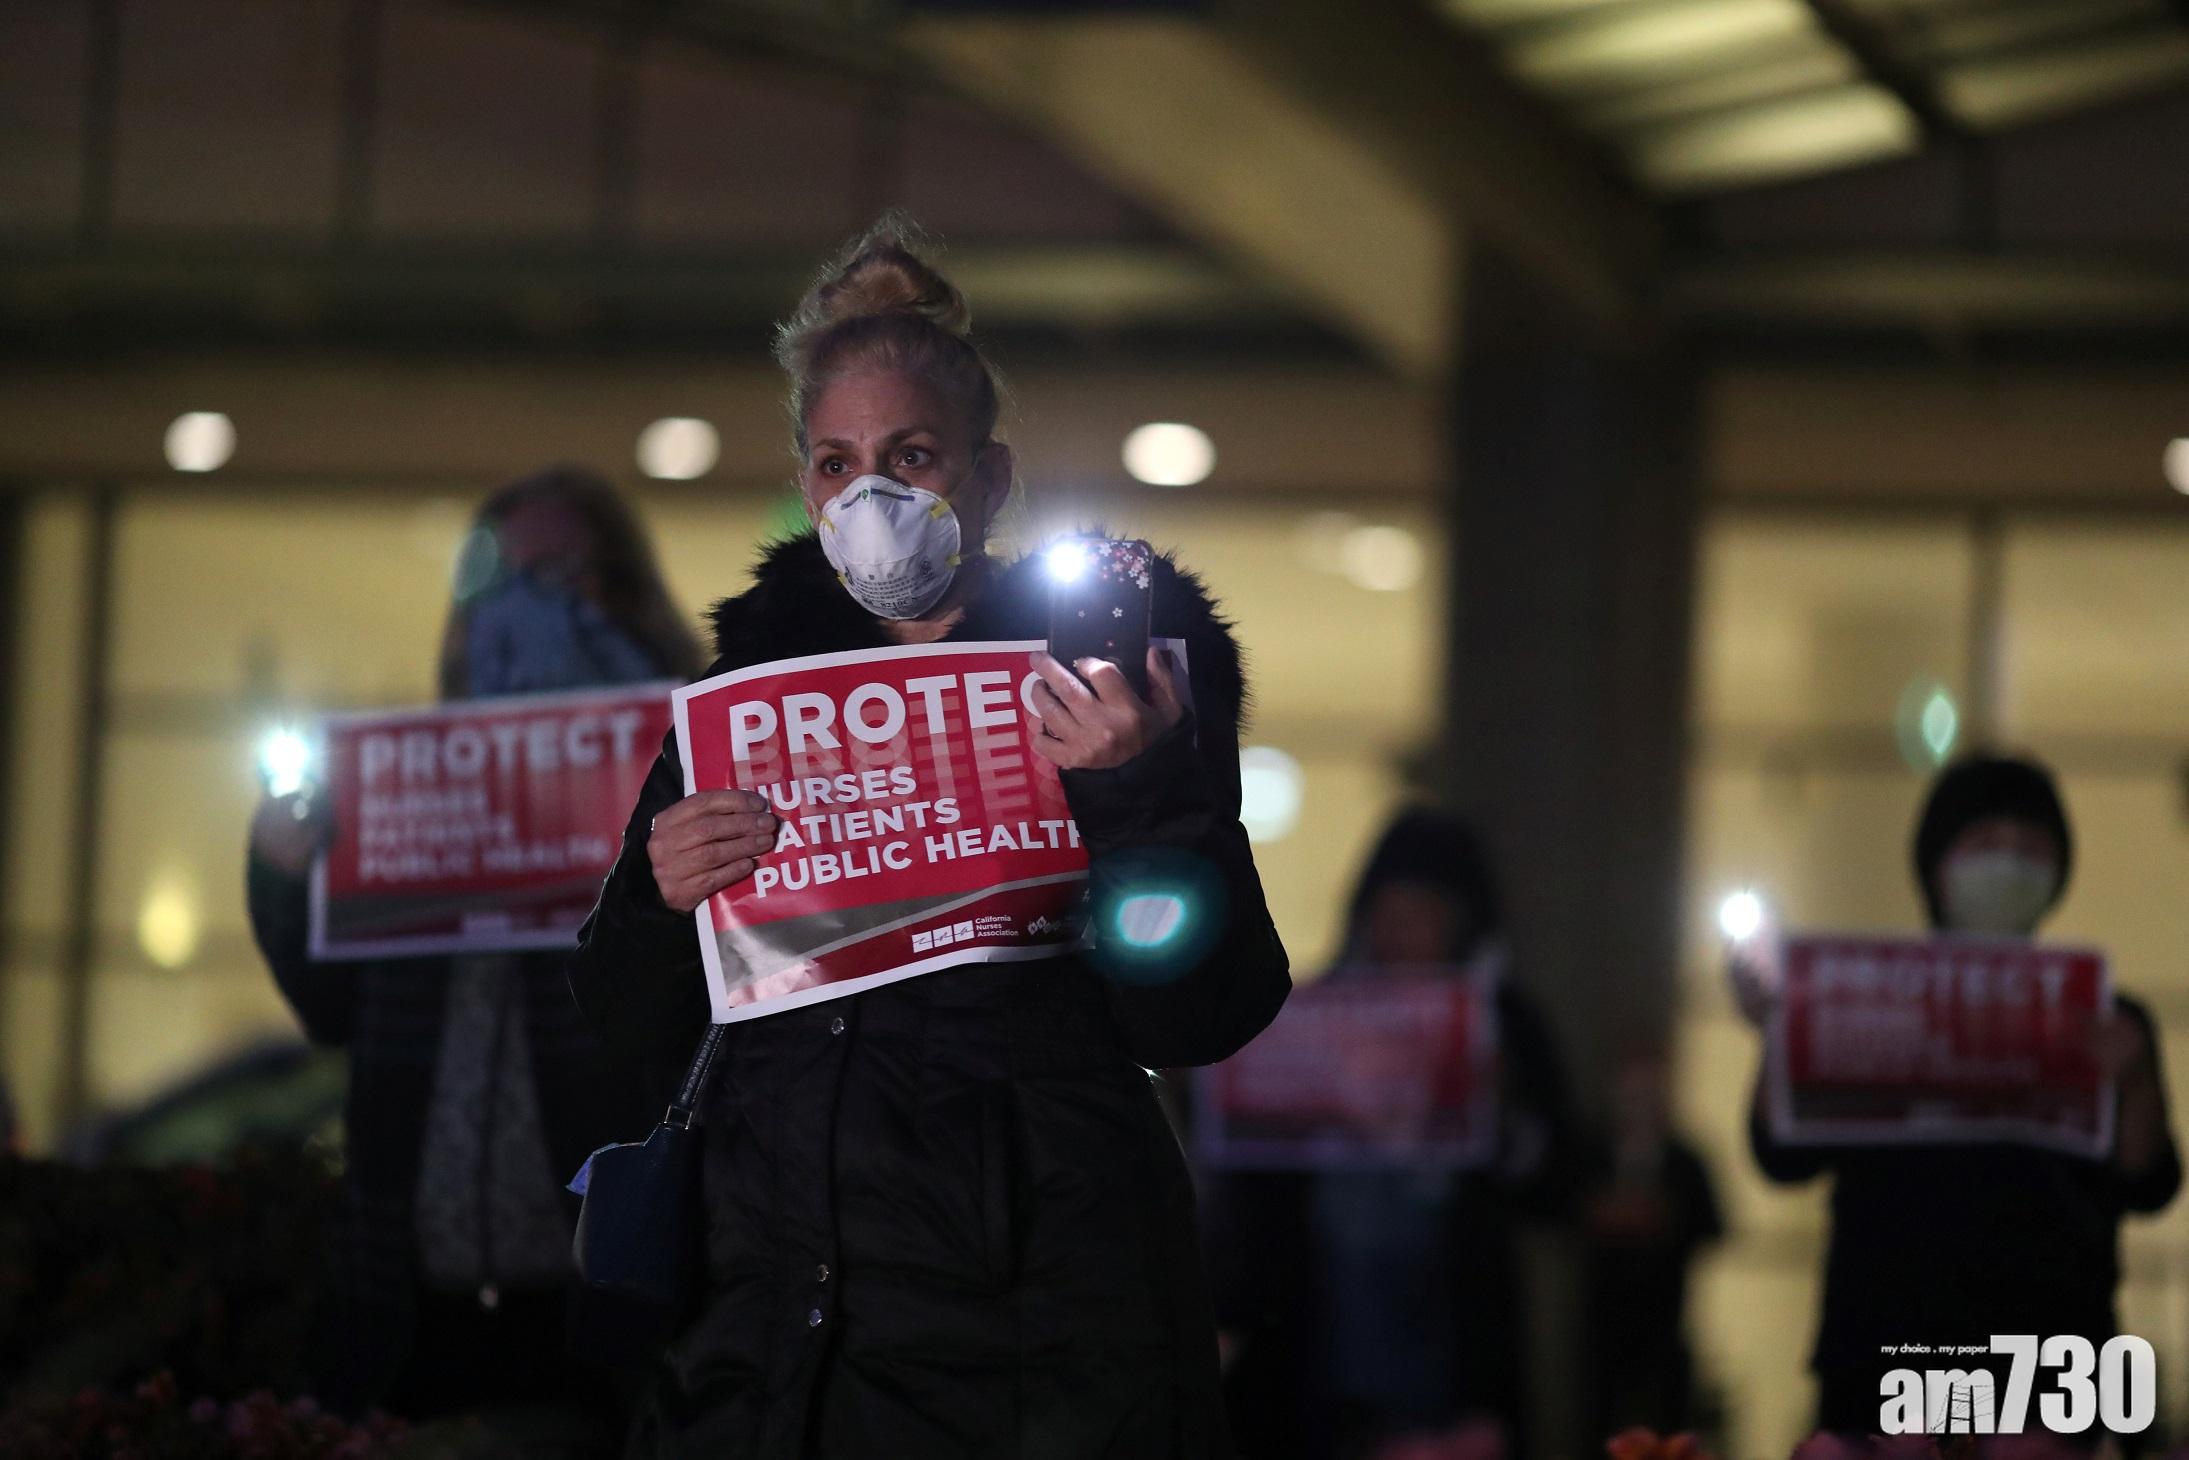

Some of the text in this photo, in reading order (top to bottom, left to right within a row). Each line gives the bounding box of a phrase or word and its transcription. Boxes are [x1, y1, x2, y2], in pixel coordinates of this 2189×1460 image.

[729, 670, 1043, 762] PROTE
[359, 709, 646, 784] PROTECT
[775, 797, 961, 854] ATIENTS
[754, 840, 912, 898] PUBLIC
[975, 915, 1012, 924] California
[976, 923, 1002, 931] Nurses
